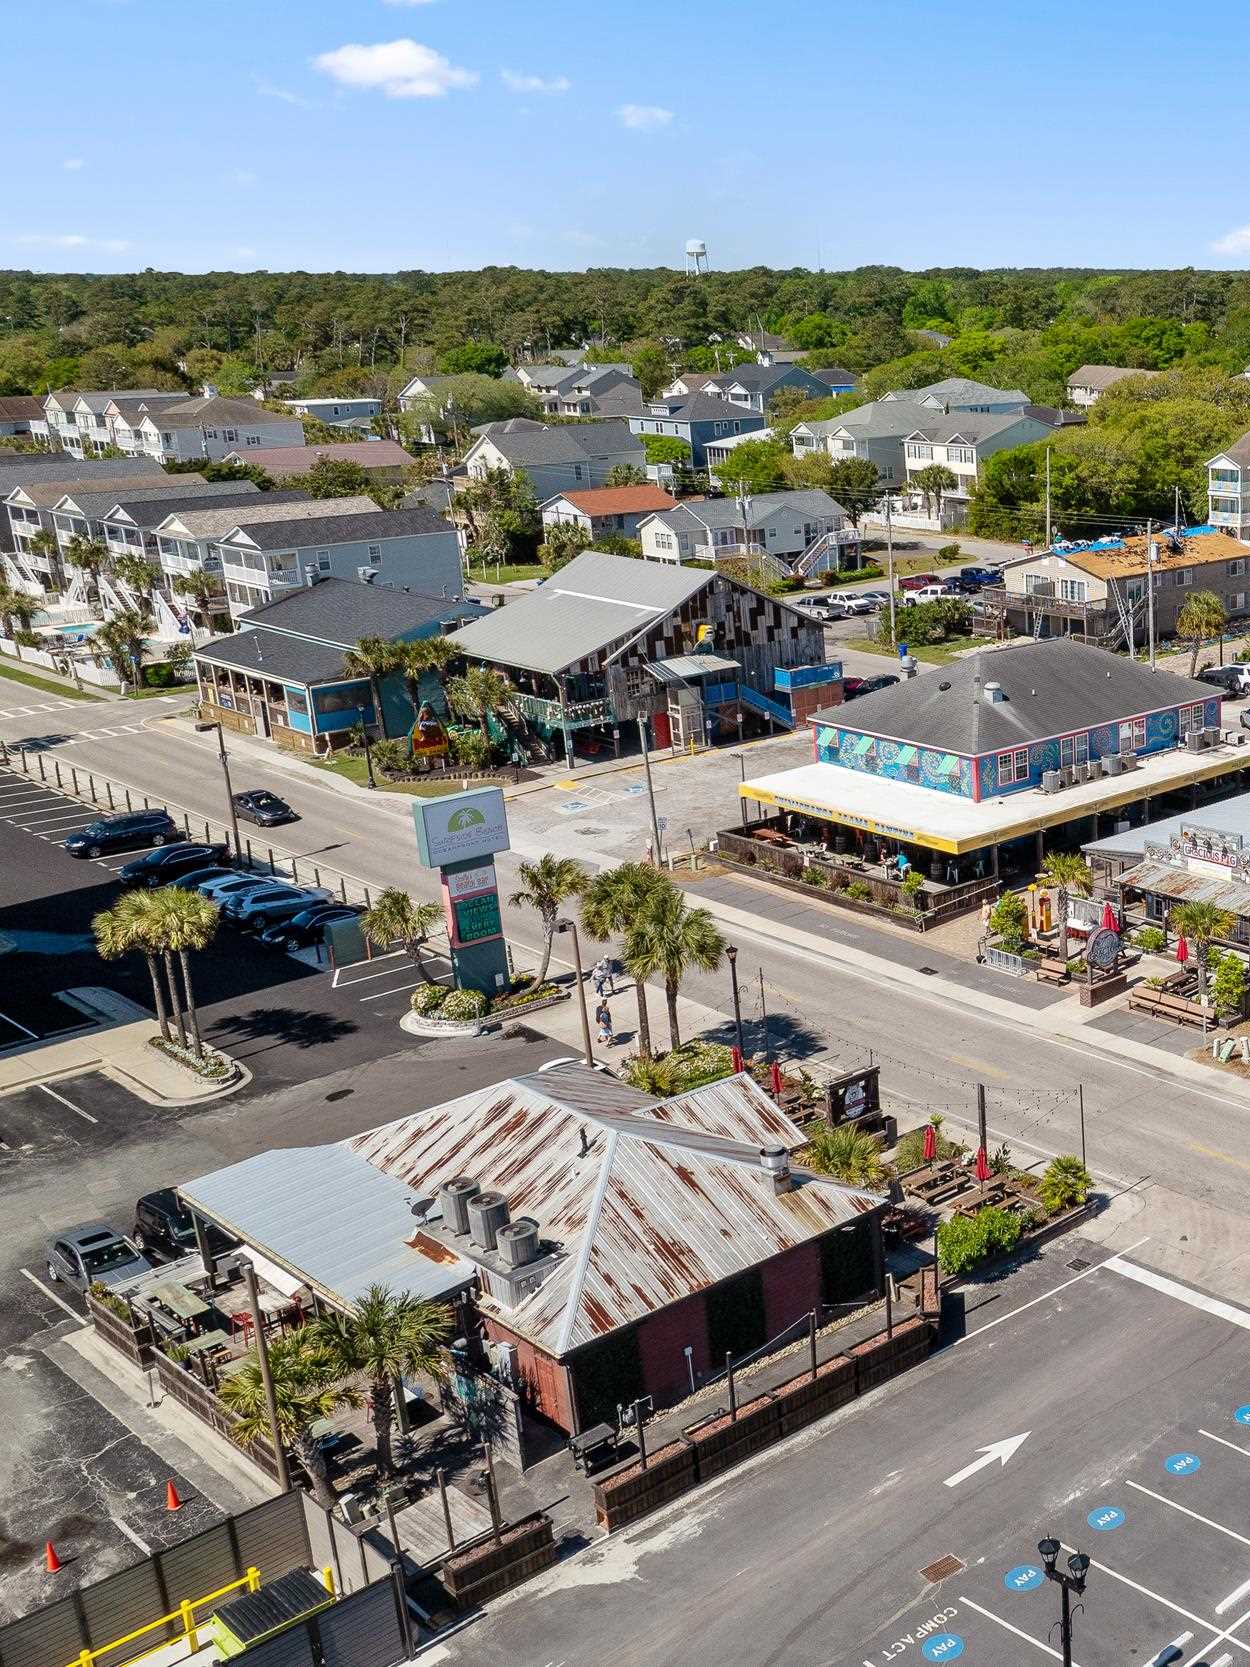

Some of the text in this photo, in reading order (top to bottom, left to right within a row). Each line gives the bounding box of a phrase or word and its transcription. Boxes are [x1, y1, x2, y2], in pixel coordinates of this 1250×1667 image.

[1185, 845, 1237, 866] GRACIOUS PIG
[1173, 1456, 1193, 1471] PAY
[1097, 1511, 1118, 1526] PAY
[1014, 1569, 1036, 1587] PAY
[881, 1606, 958, 1661] COMPACT
[931, 1638, 956, 1657] PAY
